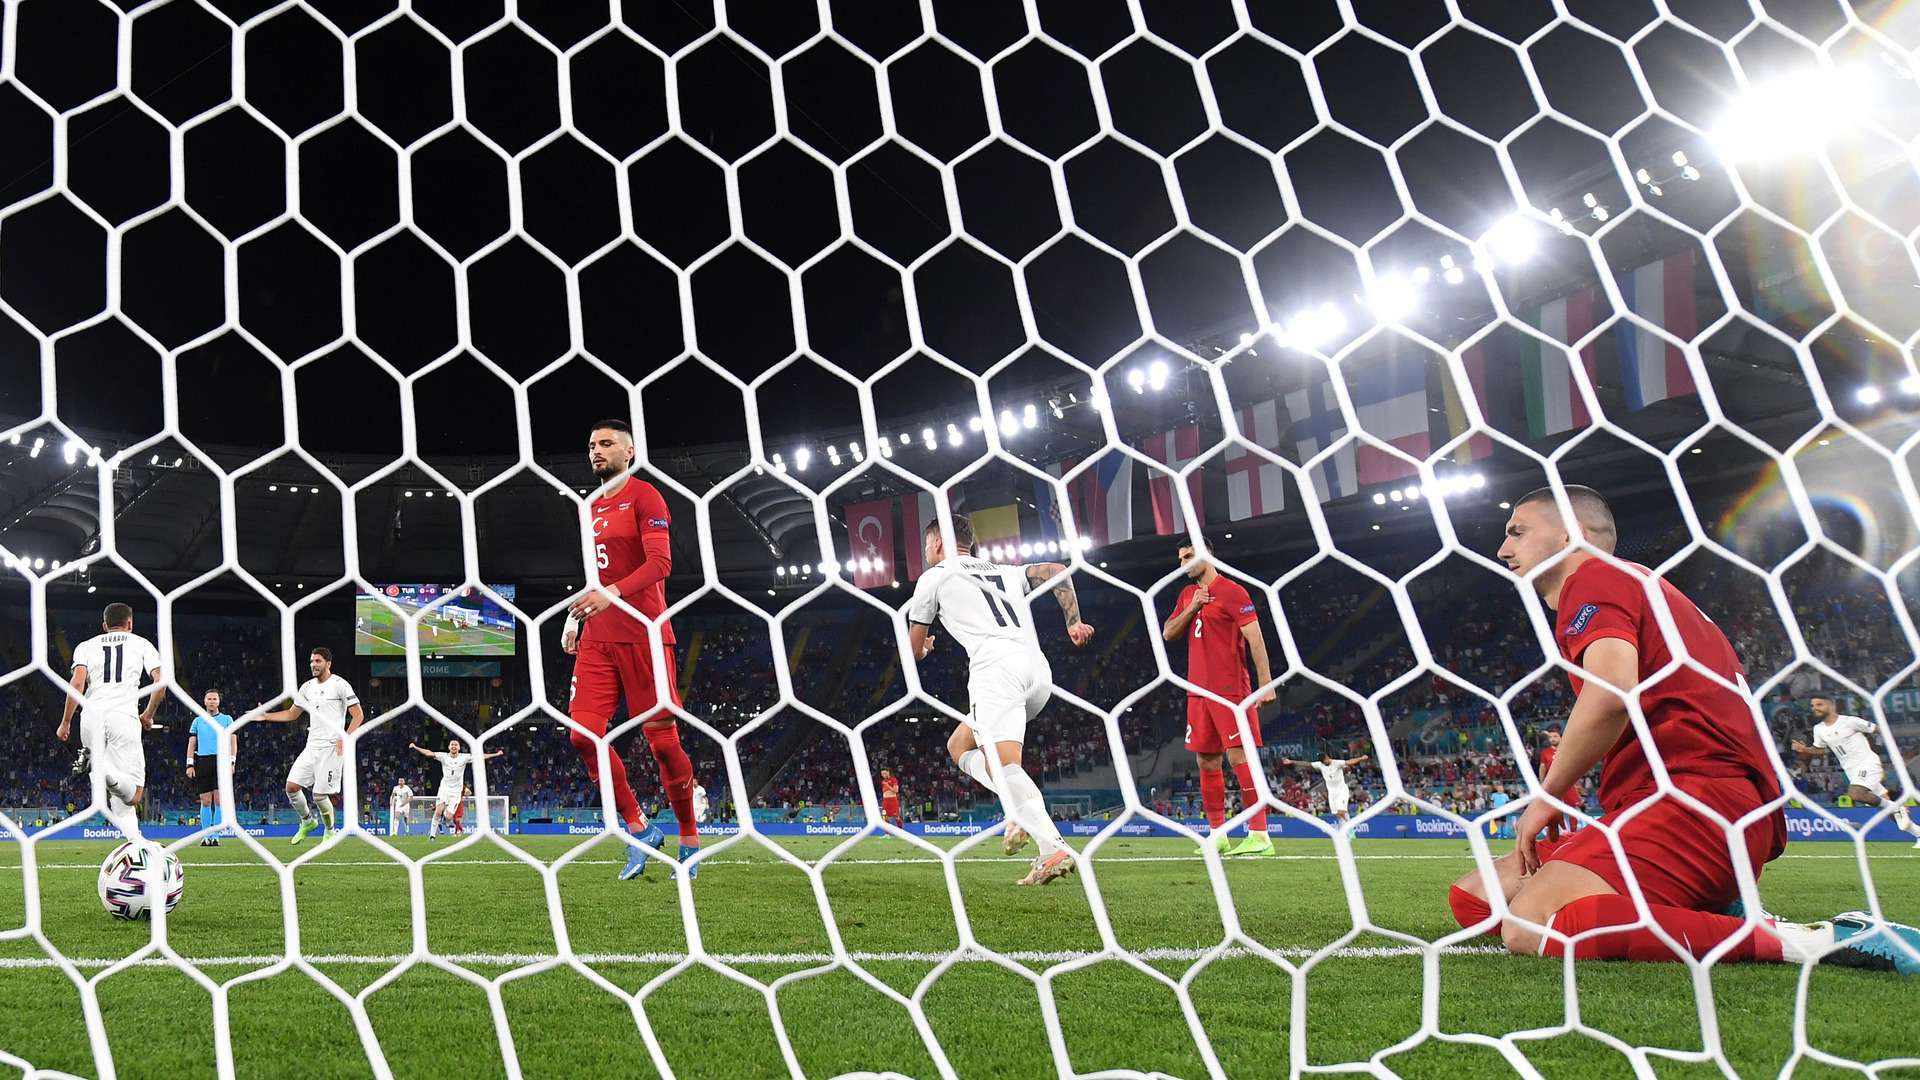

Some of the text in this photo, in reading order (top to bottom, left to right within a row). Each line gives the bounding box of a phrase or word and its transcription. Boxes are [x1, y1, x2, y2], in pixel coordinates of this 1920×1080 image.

[970, 574, 1021, 628] 17
[1194, 618, 1202, 638] 2
[102, 643, 123, 683] 11
[423, 665, 449, 674] ROME
[1184, 724, 1193, 744] 2
[327, 770, 334, 783] 5
[806, 824, 864, 836] Booking.com
[924, 824, 982, 835] Booking.com
